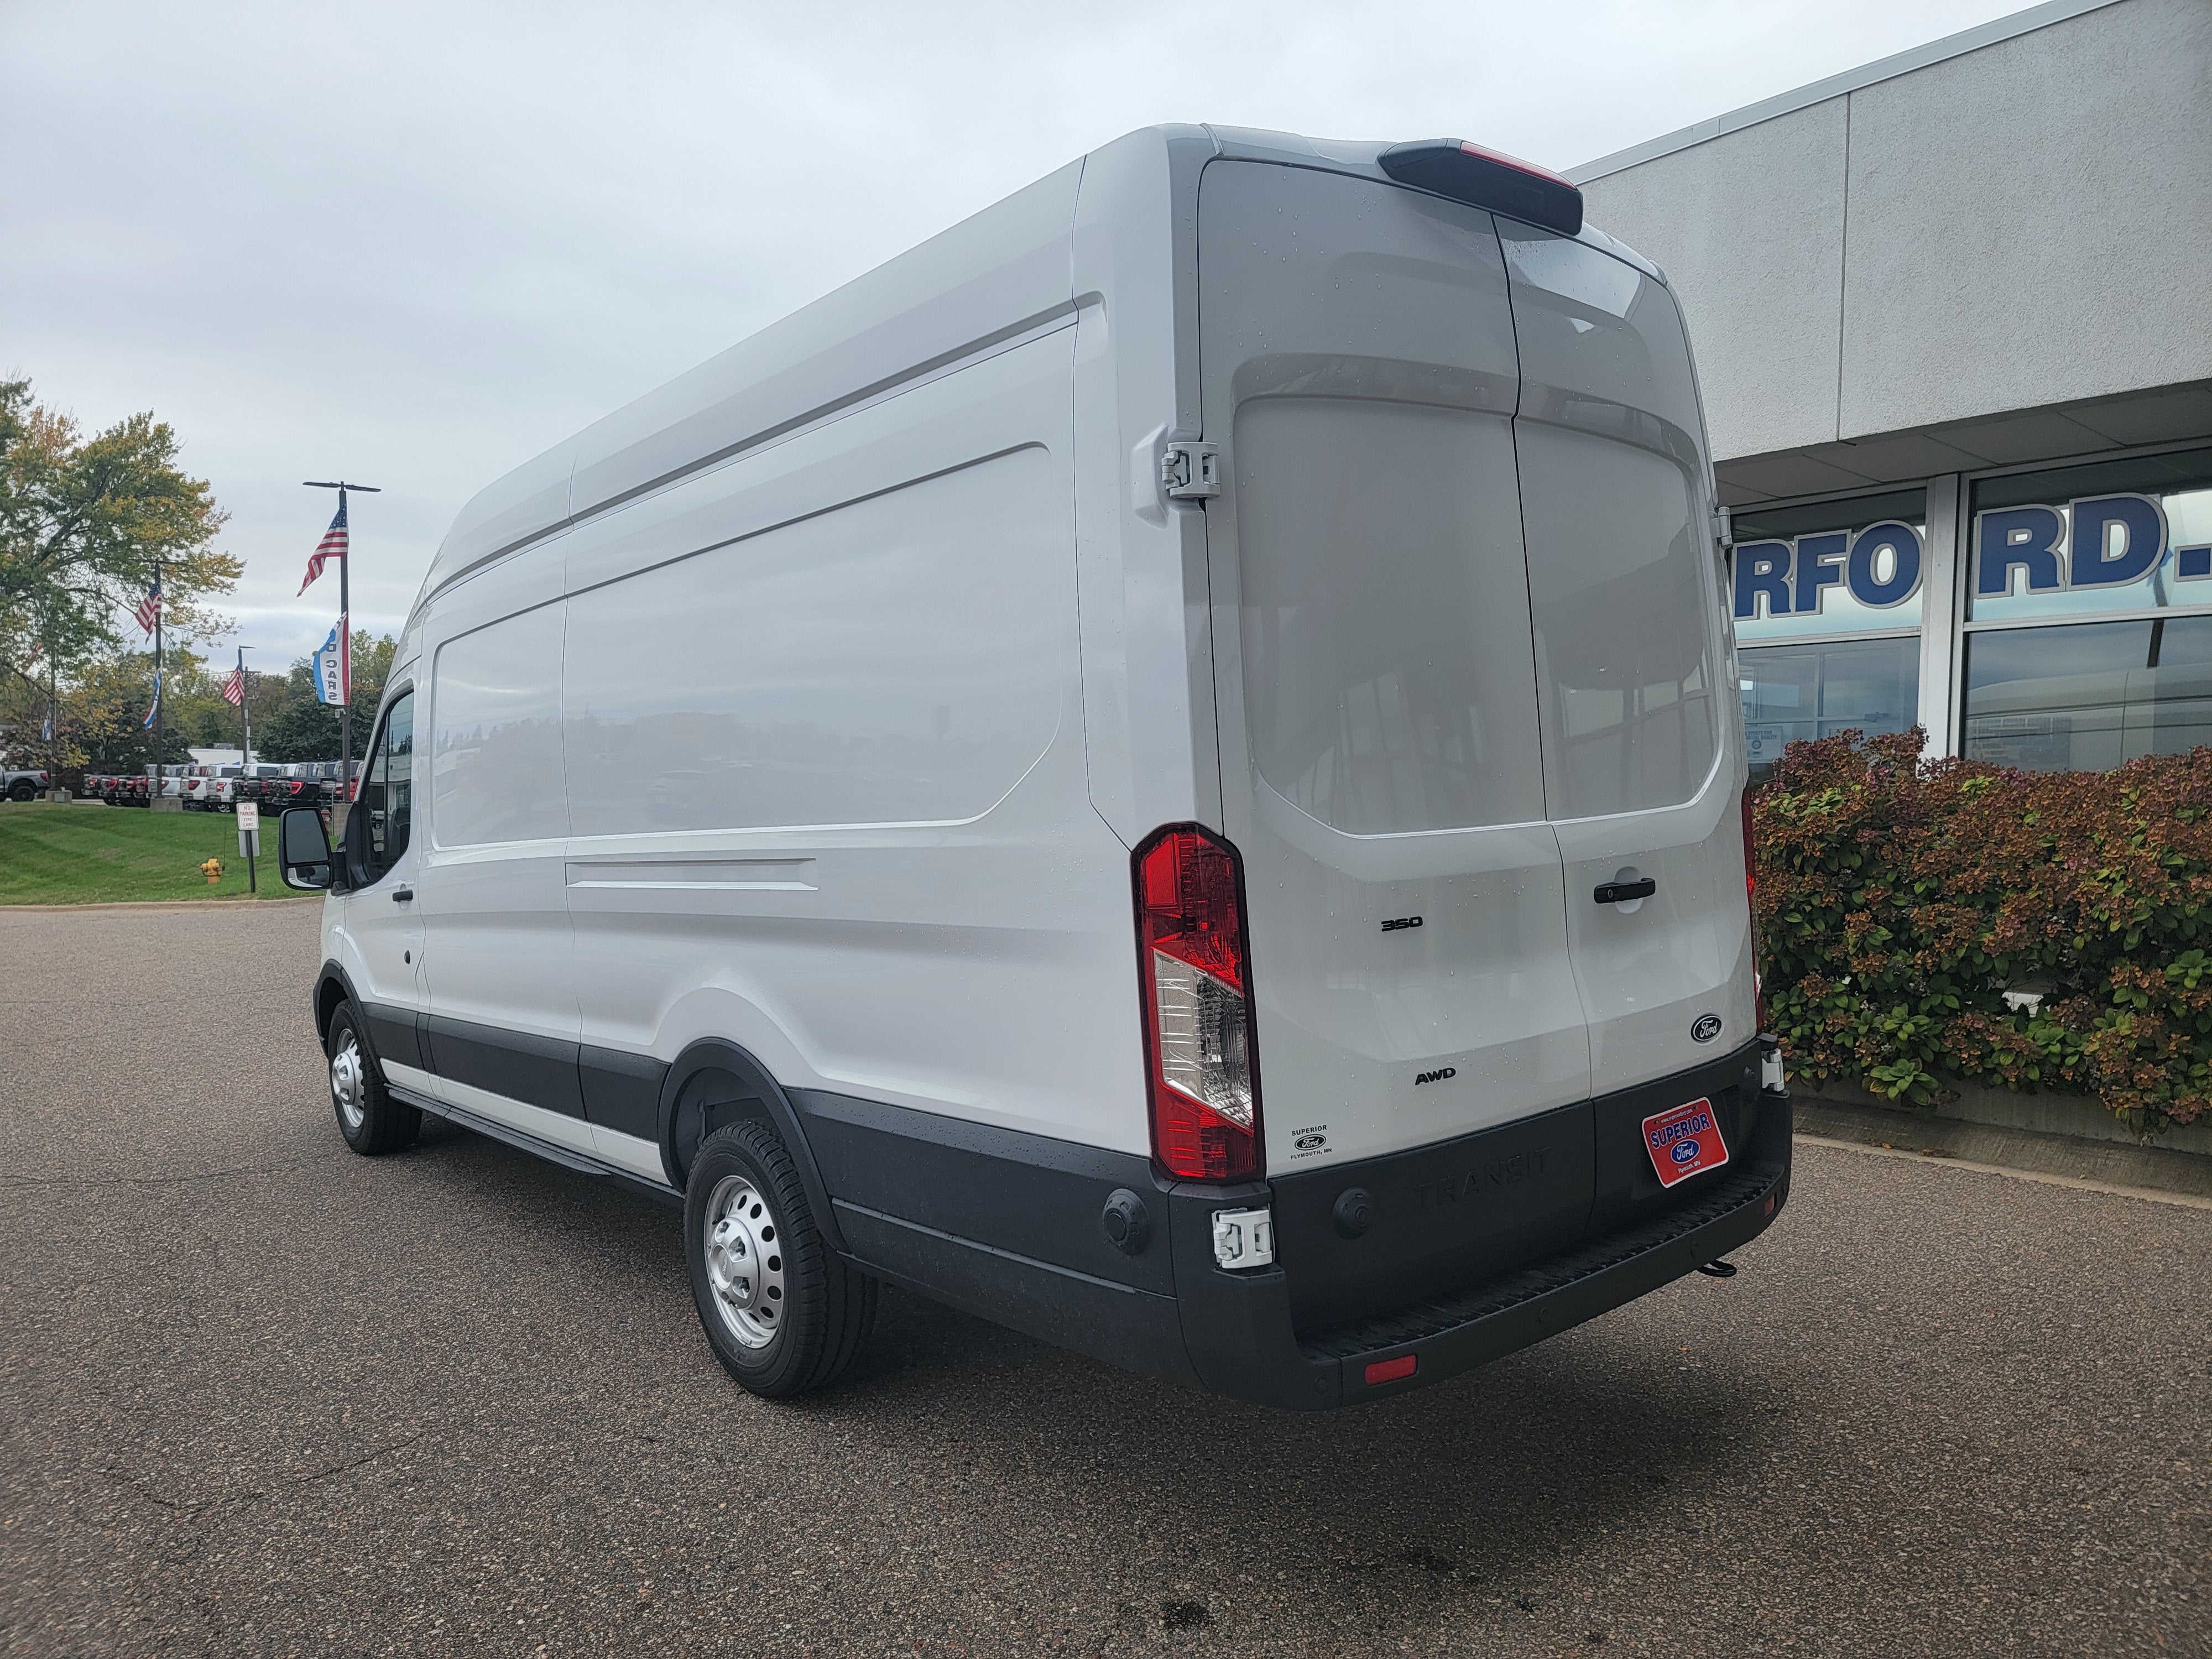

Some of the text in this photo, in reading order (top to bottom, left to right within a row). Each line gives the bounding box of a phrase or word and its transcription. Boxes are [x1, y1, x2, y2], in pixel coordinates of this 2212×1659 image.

[1381, 916, 1423, 932] 350
[1415, 1067, 1457, 1086] AWD
[1291, 1125, 1327, 1136] SUPERIOR
[1650, 1112, 1712, 1150] SUPERIOR
[1290, 1150, 1322, 1160] PLYMOUTH,
[1414, 1145, 1552, 1210] TRANSIT
